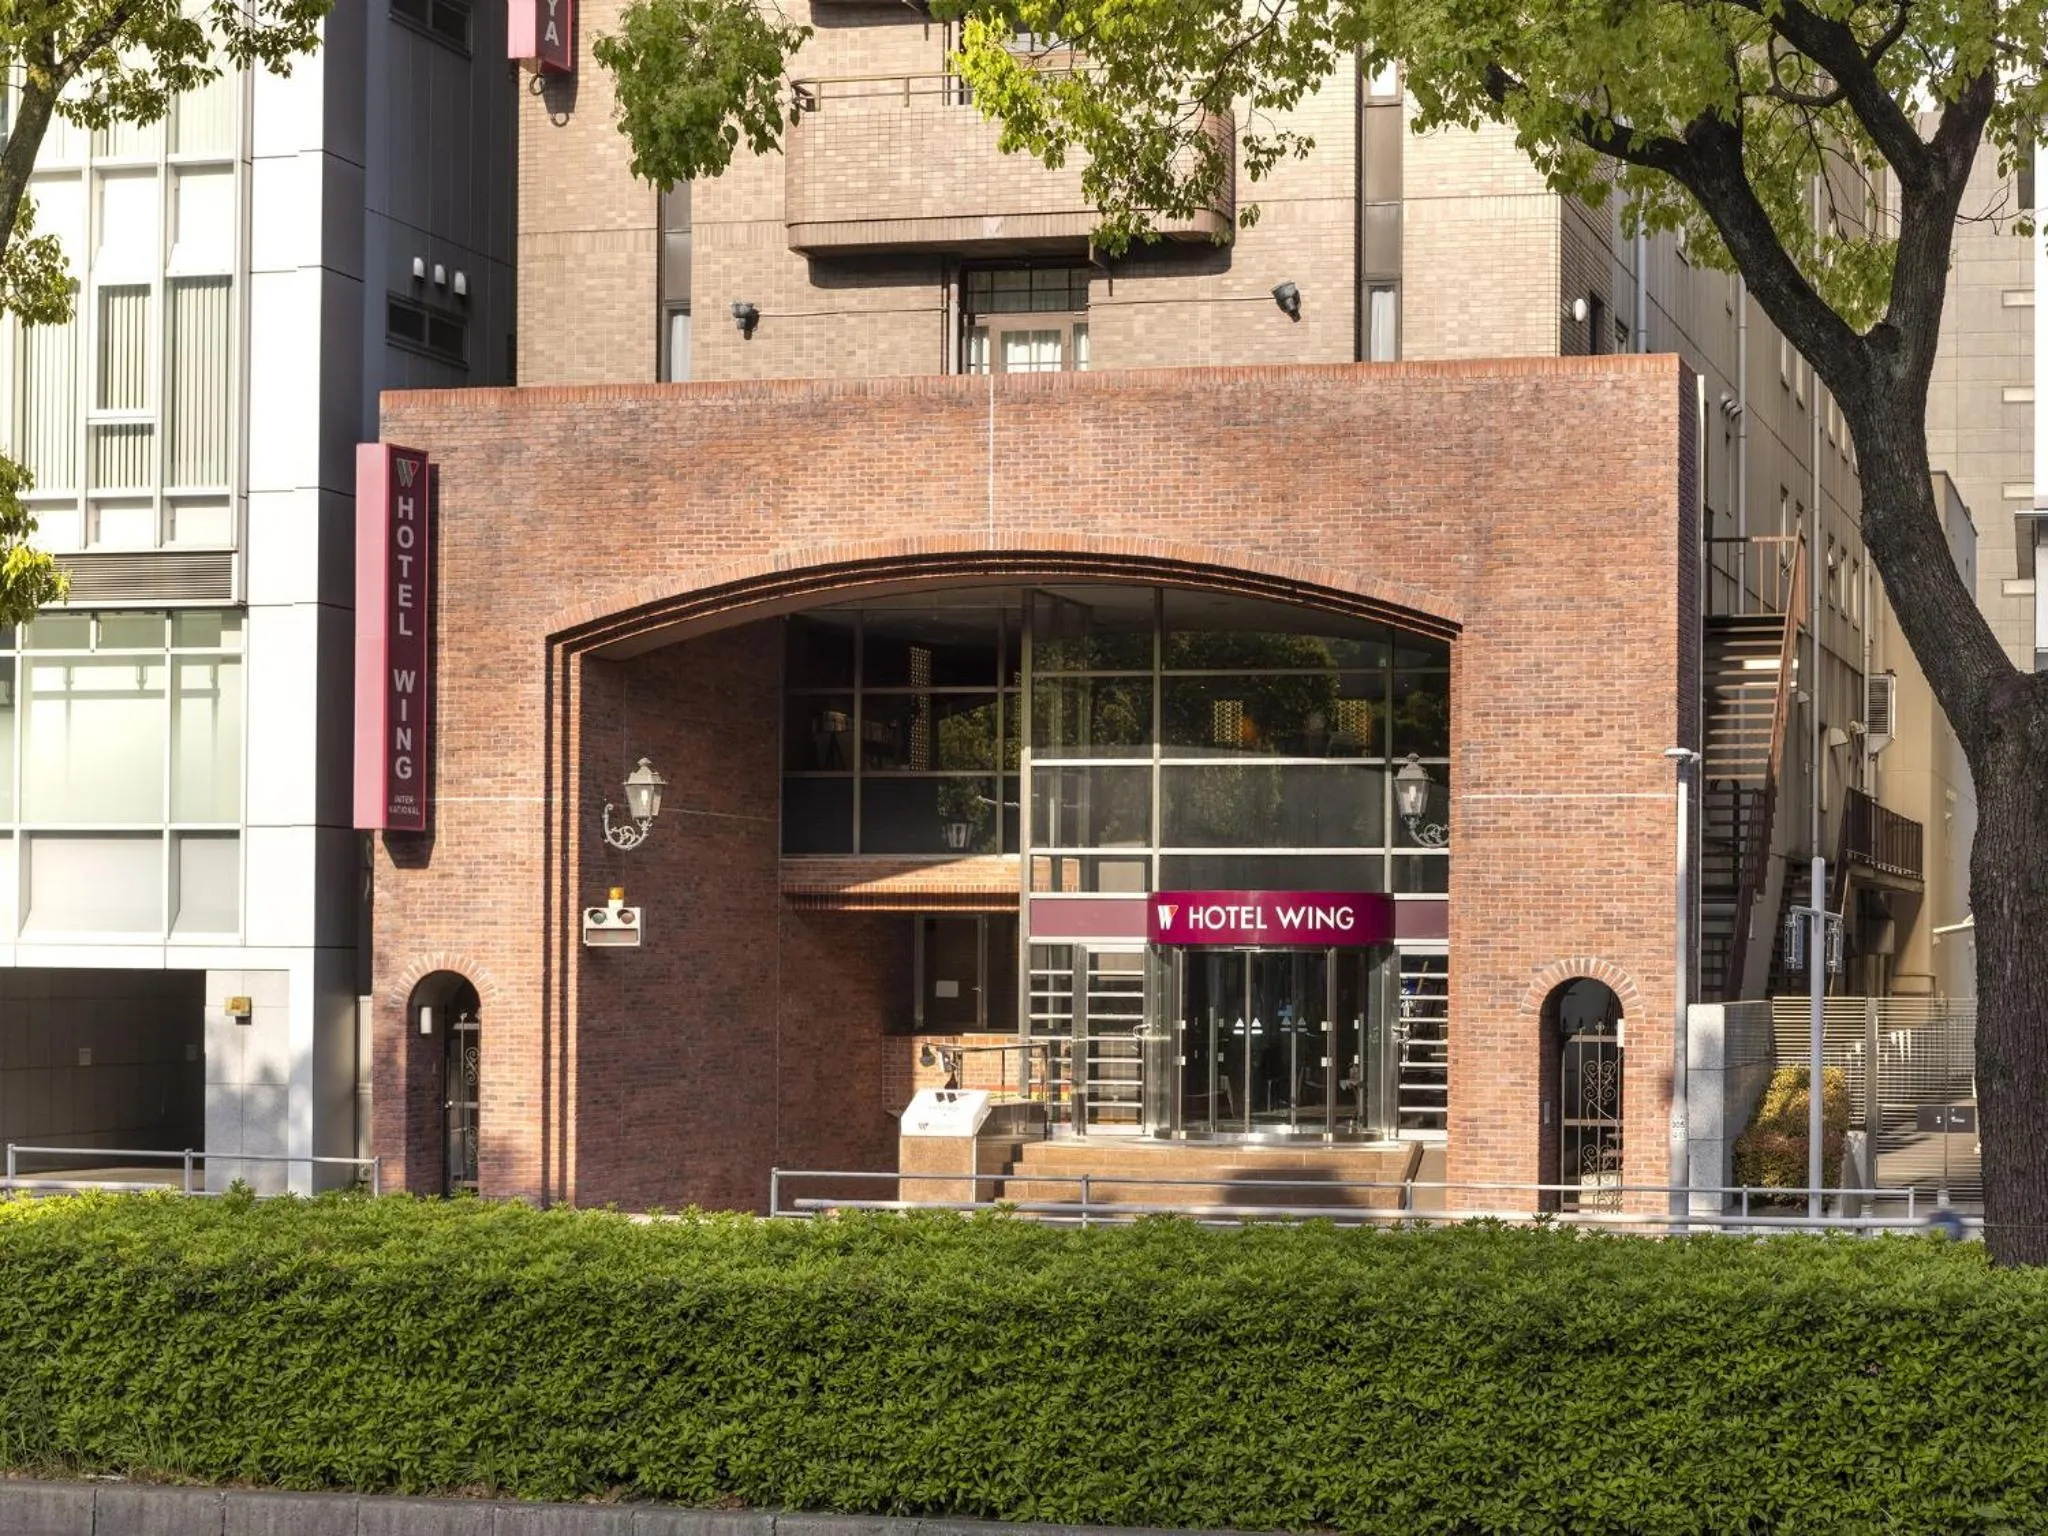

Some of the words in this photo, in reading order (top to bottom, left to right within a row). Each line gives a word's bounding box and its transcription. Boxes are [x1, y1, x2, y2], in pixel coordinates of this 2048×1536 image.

[397, 496, 415, 636] HOTEL
[394, 668, 416, 779] WING
[1188, 905, 1268, 930] HOTEL
[1275, 905, 1355, 930] WING
